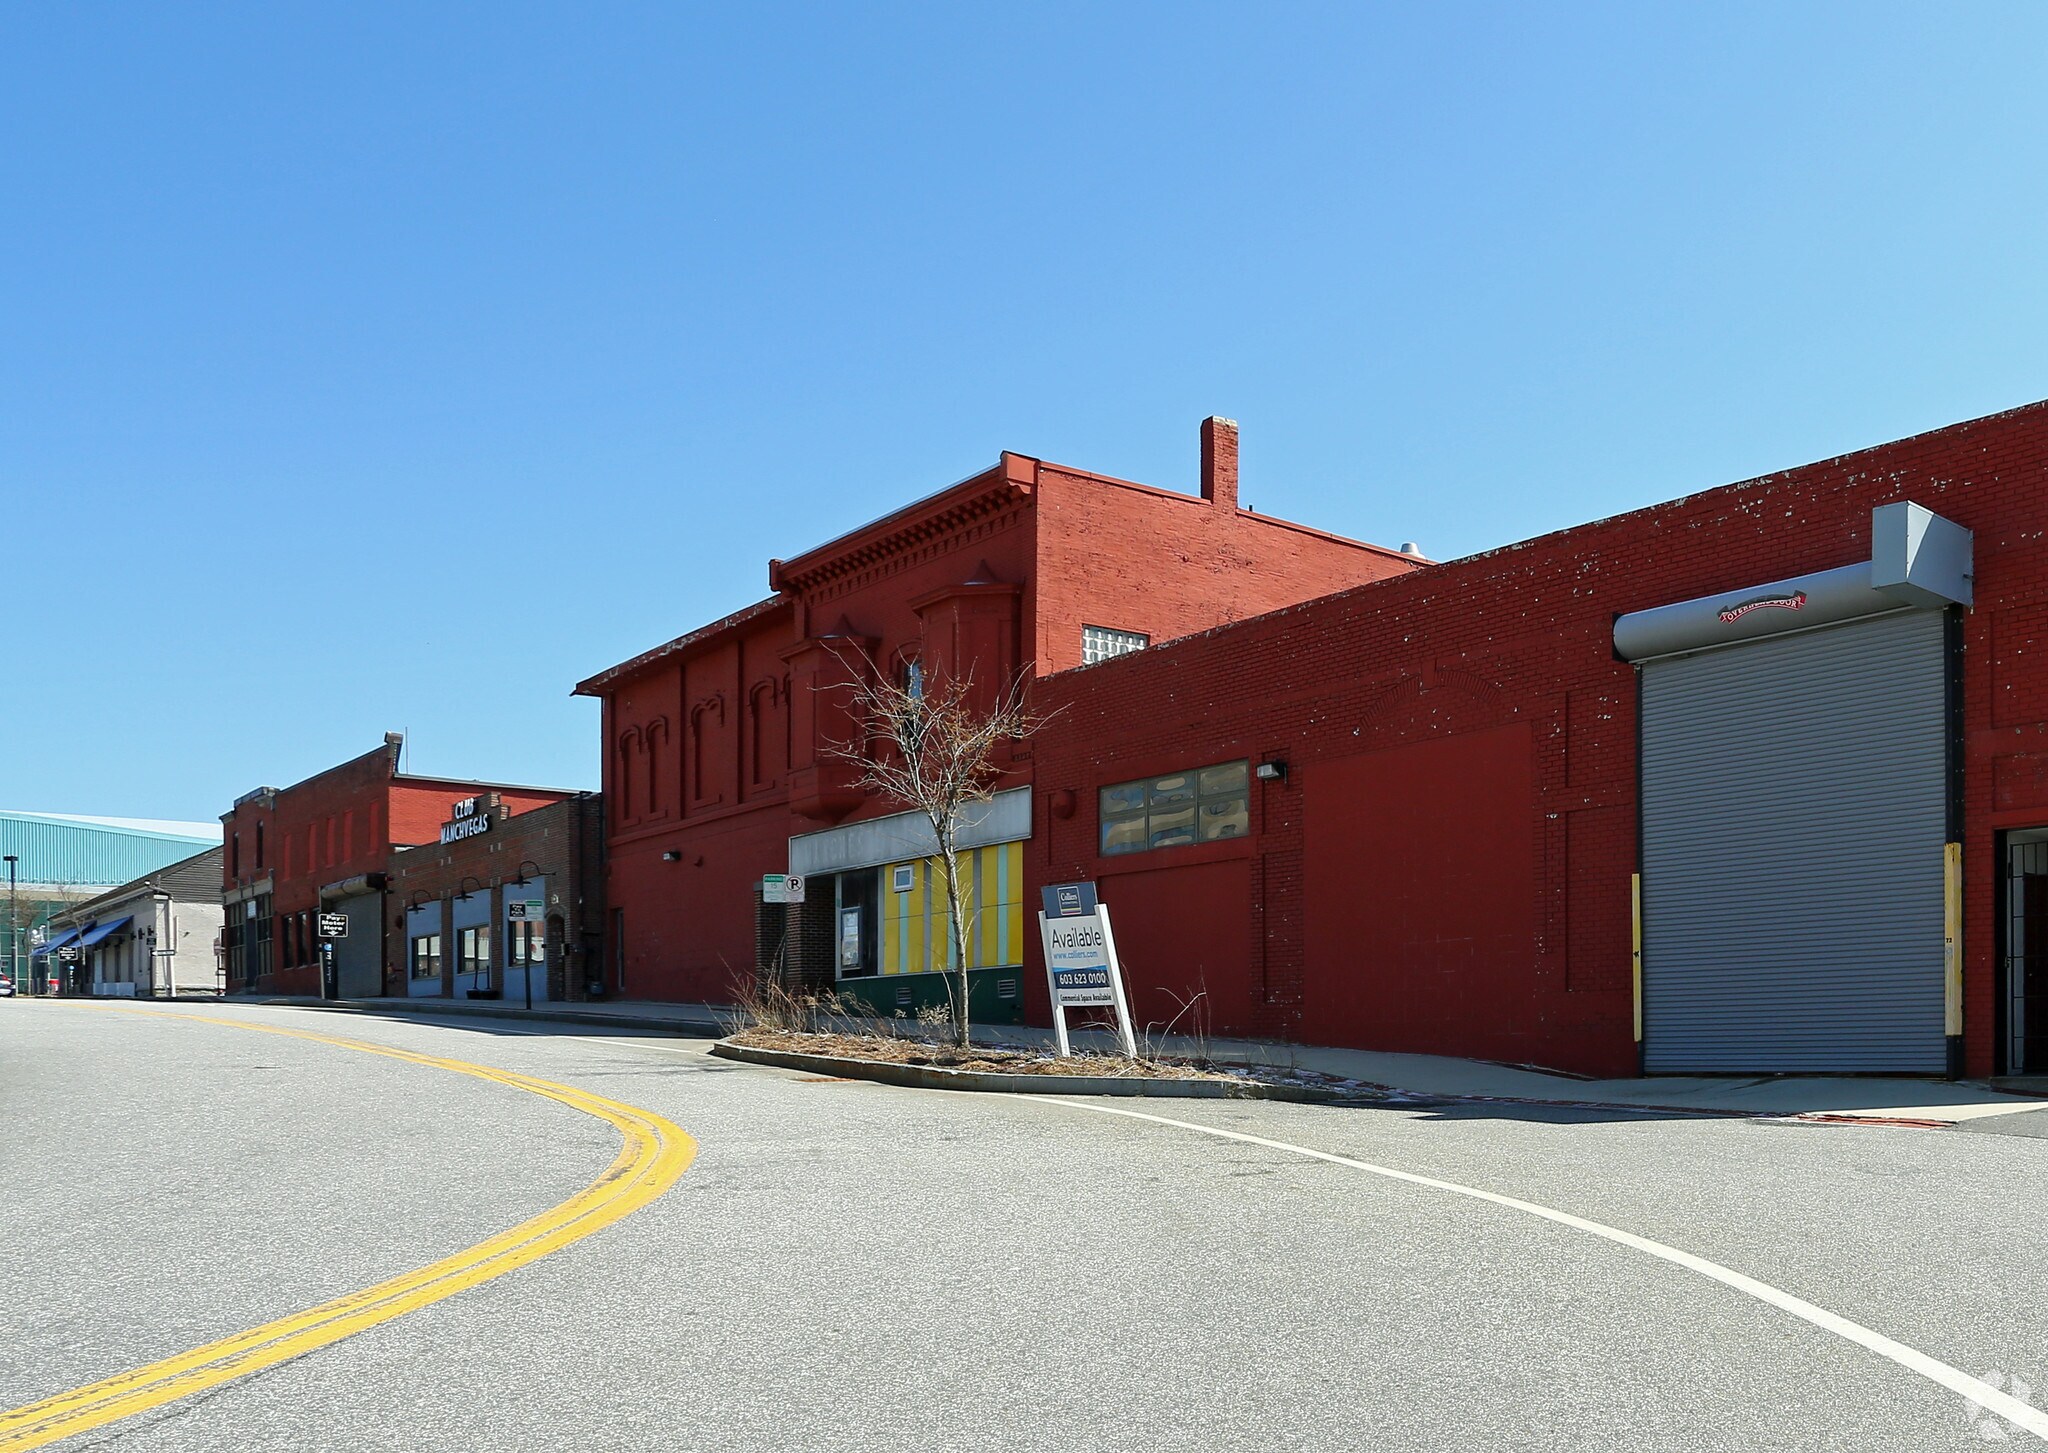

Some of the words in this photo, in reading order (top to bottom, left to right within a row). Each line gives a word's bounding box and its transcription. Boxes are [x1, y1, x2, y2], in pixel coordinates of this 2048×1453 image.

[455, 797, 475, 819] CLUB
[440, 813, 488, 845] MANCHVEGAS
[1052, 926, 1102, 948] Available
[1053, 950, 1098, 959] www.colliers.com
[1059, 973, 1073, 985] 603
[1074, 973, 1087, 984] 623
[1088, 972, 1106, 984] 0100
